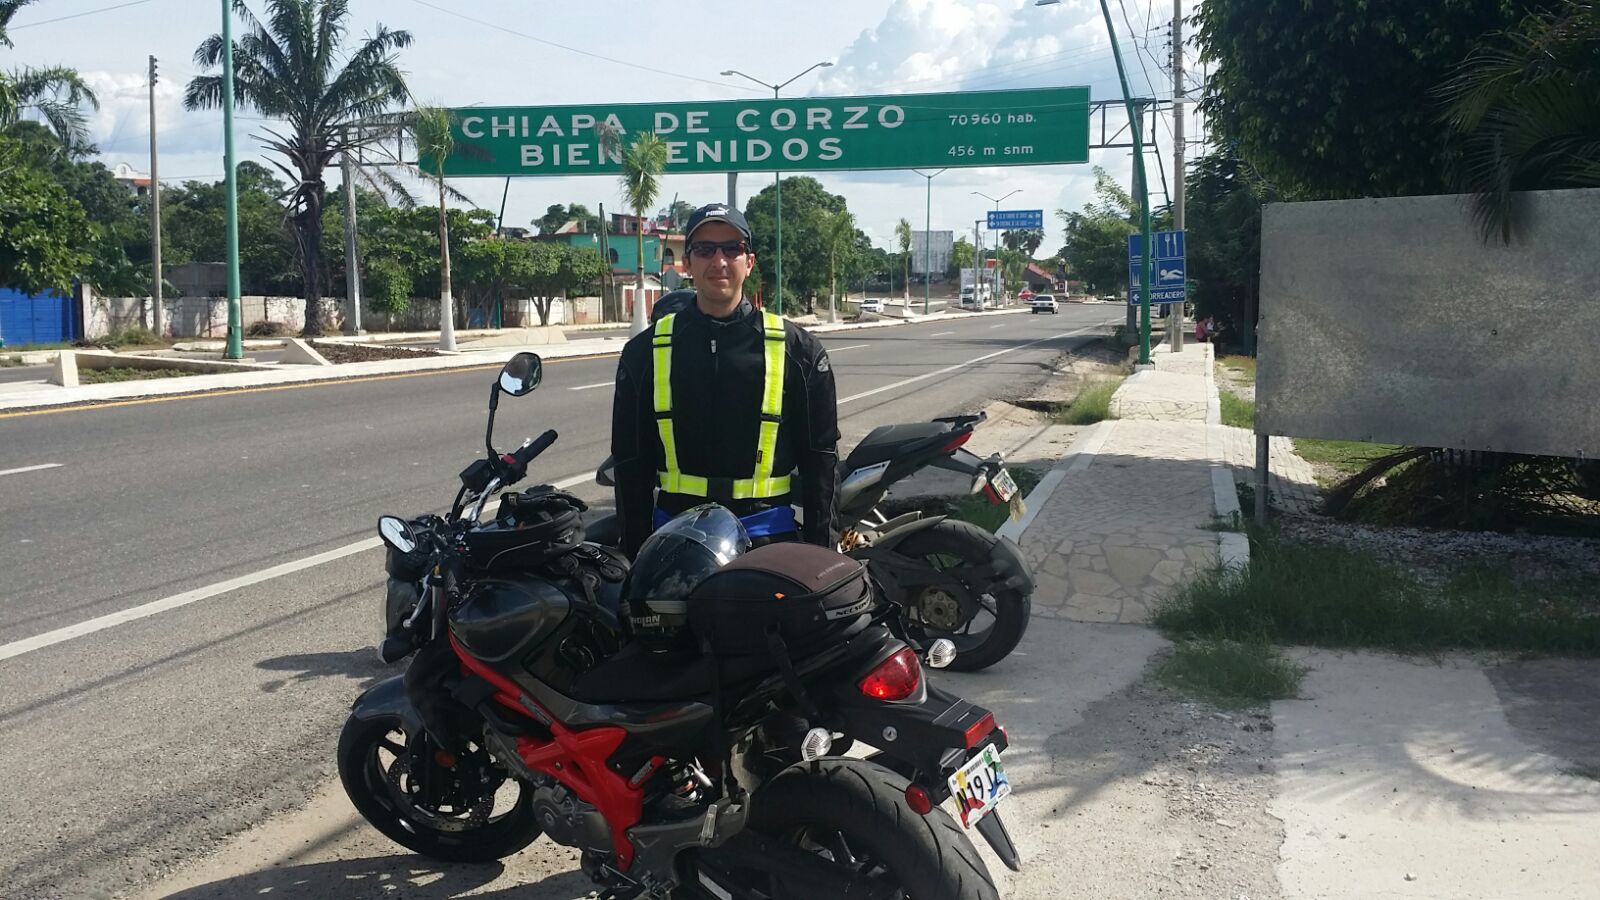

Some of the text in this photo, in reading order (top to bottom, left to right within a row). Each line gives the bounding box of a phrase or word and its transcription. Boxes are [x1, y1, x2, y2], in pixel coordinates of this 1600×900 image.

[461, 104, 906, 139] CHIAPA DE CORZO
[1007, 112, 1037, 124] hab.
[520, 137, 844, 166] BIENENIDOS
[947, 144, 1034, 157] 456 m snm
[1149, 291, 1184, 301] ORREADERO
